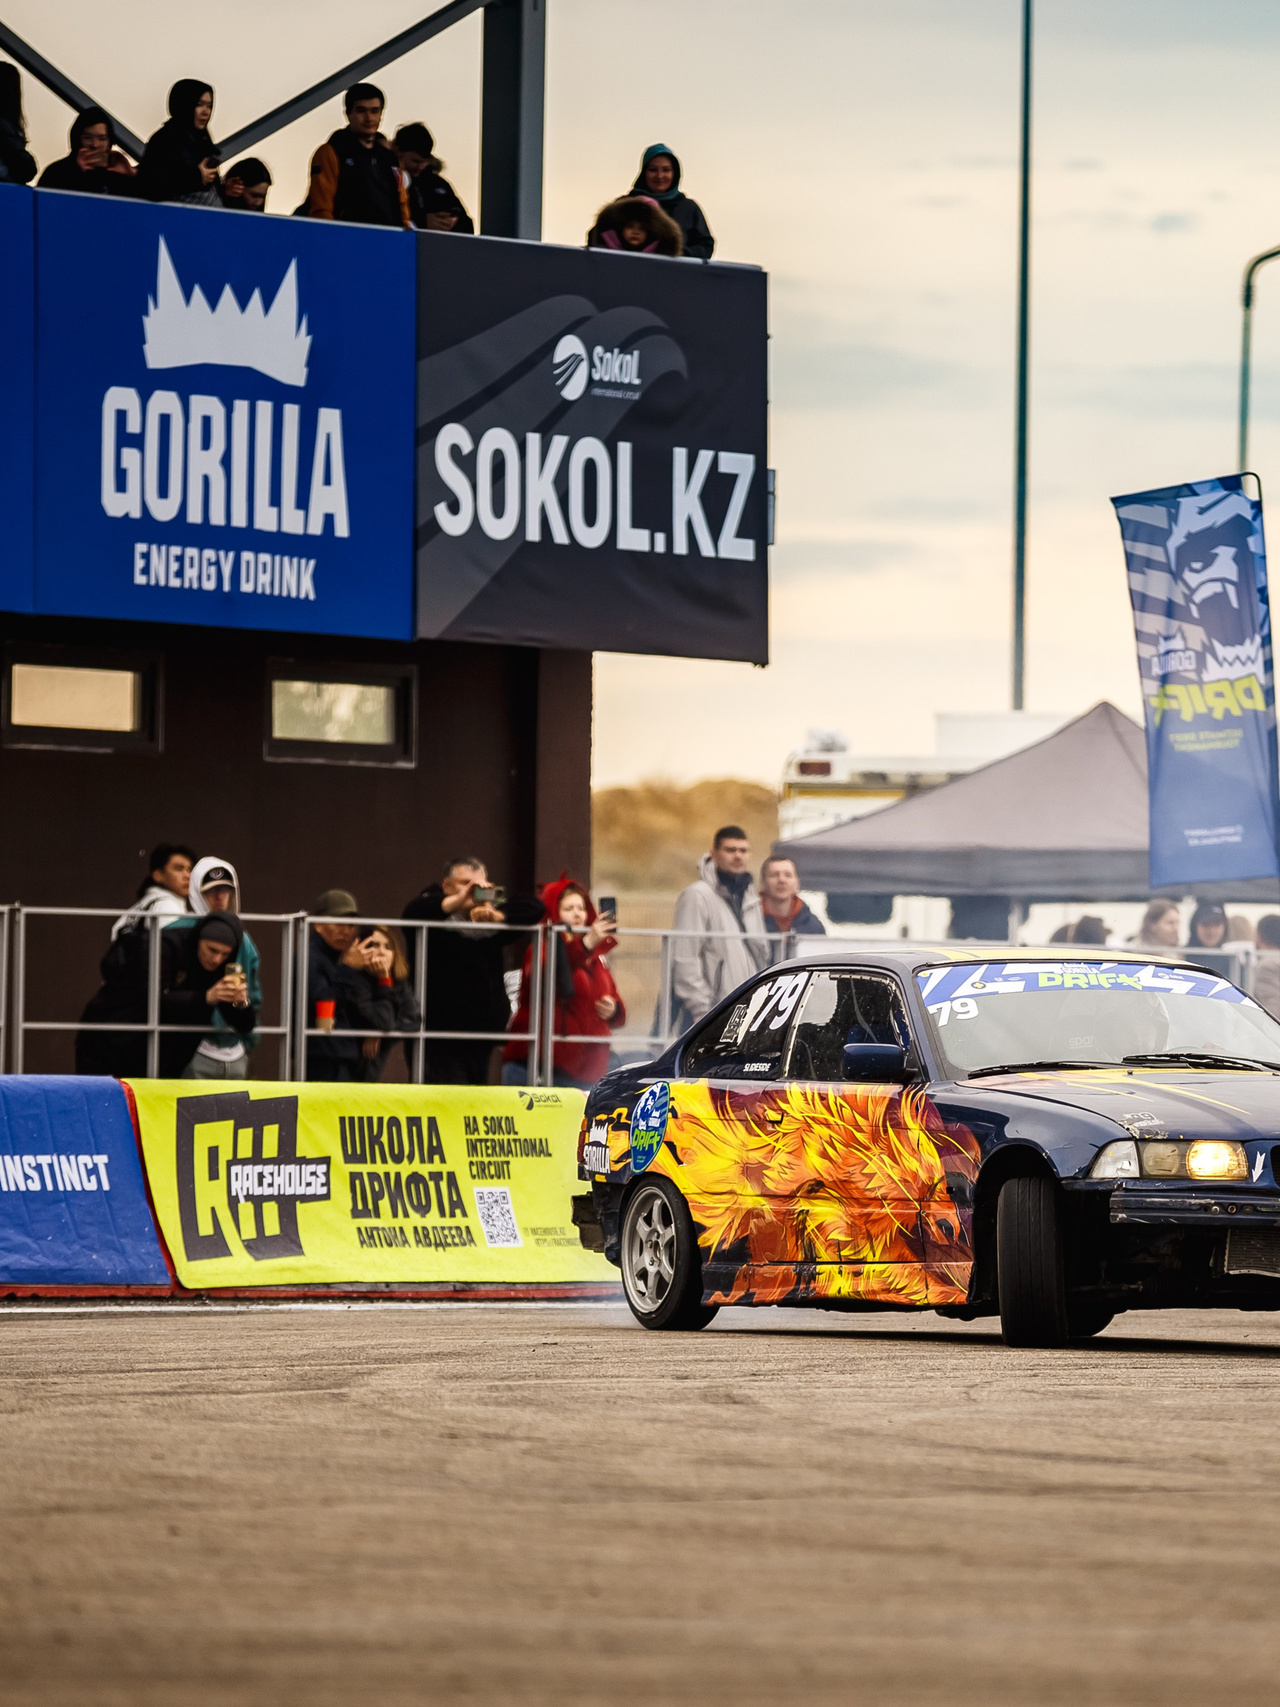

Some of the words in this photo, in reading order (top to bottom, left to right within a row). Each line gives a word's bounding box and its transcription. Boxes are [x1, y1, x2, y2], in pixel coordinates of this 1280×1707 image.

[101, 385, 349, 538] GORILLA
[434, 422, 756, 562] SOKOL.KZ
[134, 542, 233, 593] ENERGY
[240, 550, 316, 602] DRINK
[749, 971, 809, 1032] 79
[927, 997, 979, 1027] 79
[1069, 1035, 1095, 1049] spar
[338, 1116, 447, 1165] ШКОЛА
[482, 1116, 518, 1135] SOKOL
[466, 1138, 552, 1158] INTERNATIONAL
[583, 1144, 611, 1174] GORILLA
[0, 1154, 110, 1192] INSTINCT
[230, 1164, 328, 1204] RACEHOUSE
[468, 1160, 511, 1180] CIRCUIT
[348, 1171, 469, 1219] ДРИФТА
[356, 1226, 412, 1249] АНТОНА
[413, 1225, 477, 1252] АВДЕЕВА
